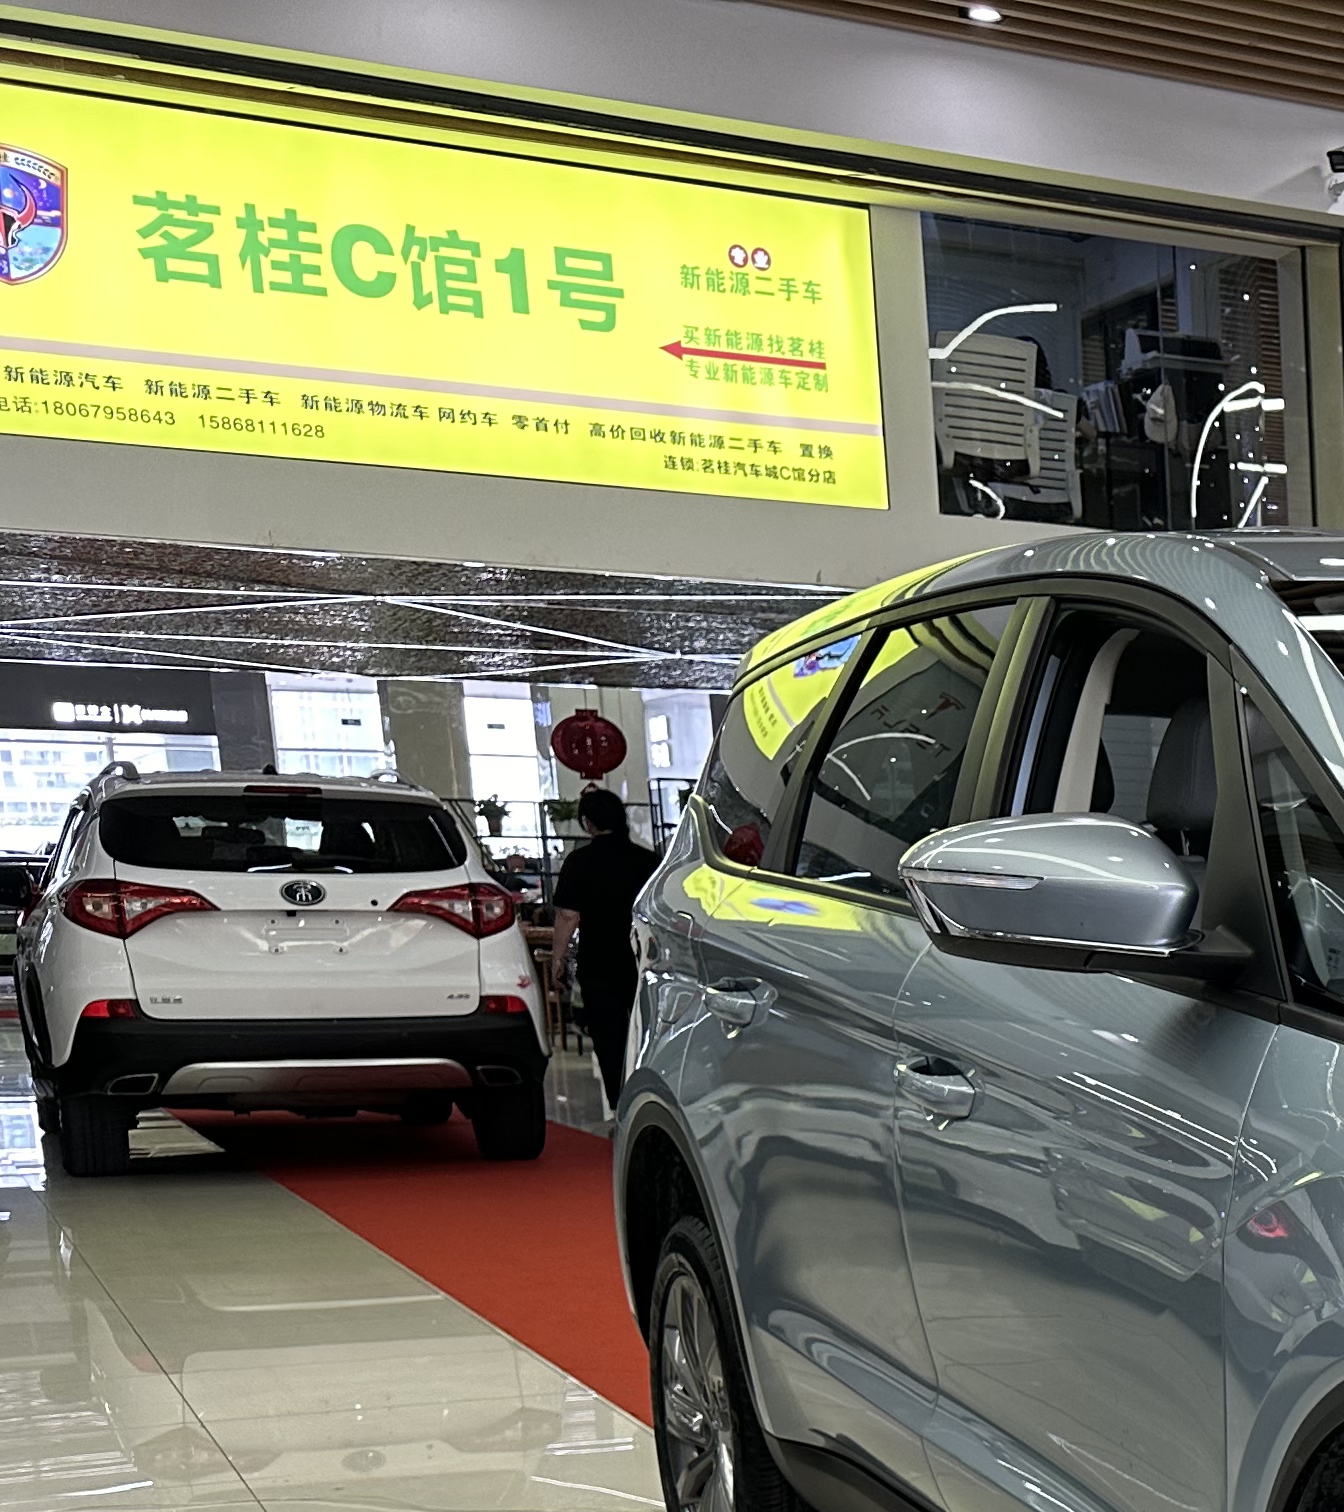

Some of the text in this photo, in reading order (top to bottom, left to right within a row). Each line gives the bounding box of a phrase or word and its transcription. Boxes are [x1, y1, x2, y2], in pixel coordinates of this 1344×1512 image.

[133, 190, 624, 332] 茗桂C馆1号
[680, 264, 822, 304] 新能源二手车
[682, 324, 826, 359] 买新能源找茗桂
[685, 358, 829, 393] 专业新能源车定制
[3, 365, 834, 460] 新能源汽车 新能源二手车 新能源物流车 网约车 零首付 高价回收新能源二手车 置换
[198, 414, 325, 439] 15868111628
[663, 455, 837, 485] 连锁:茗桂汽车城C馆分店
